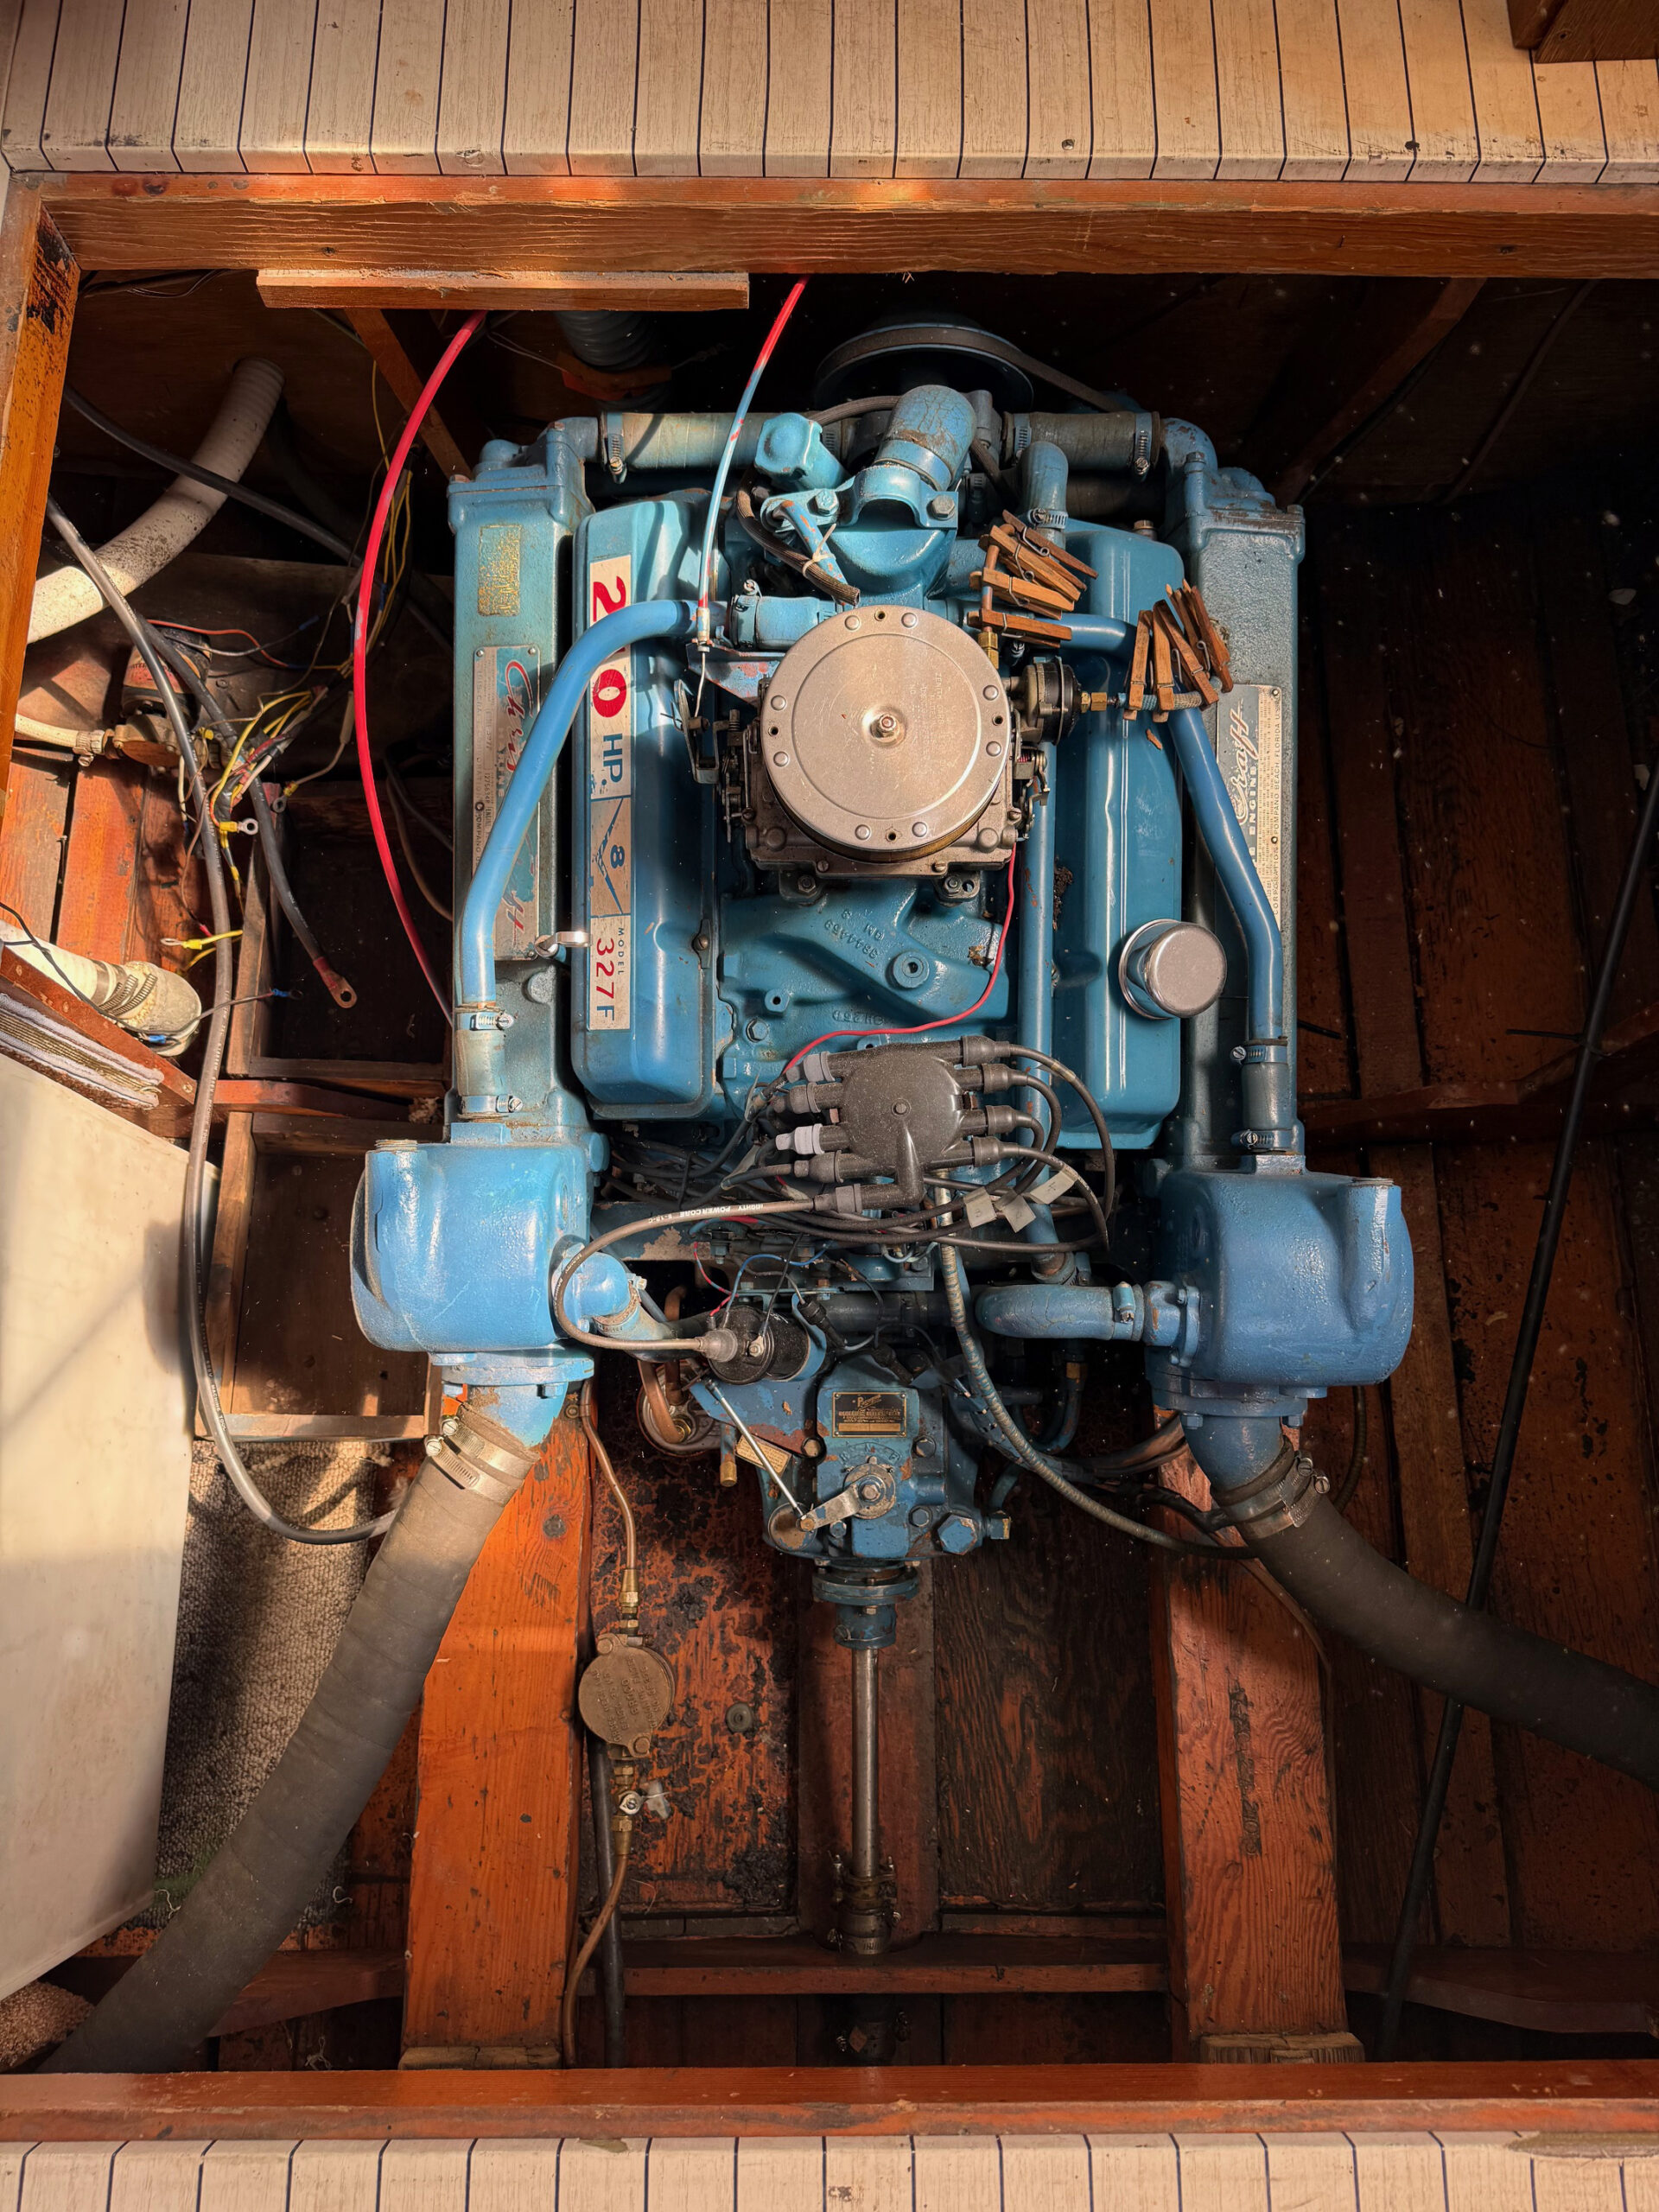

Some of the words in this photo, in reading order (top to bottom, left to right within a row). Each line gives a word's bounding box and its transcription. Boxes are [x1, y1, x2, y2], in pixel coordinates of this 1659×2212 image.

[593, 576, 626, 717] 20
[601, 734, 623, 787] HP.
[596, 938, 614, 1022] 327F
